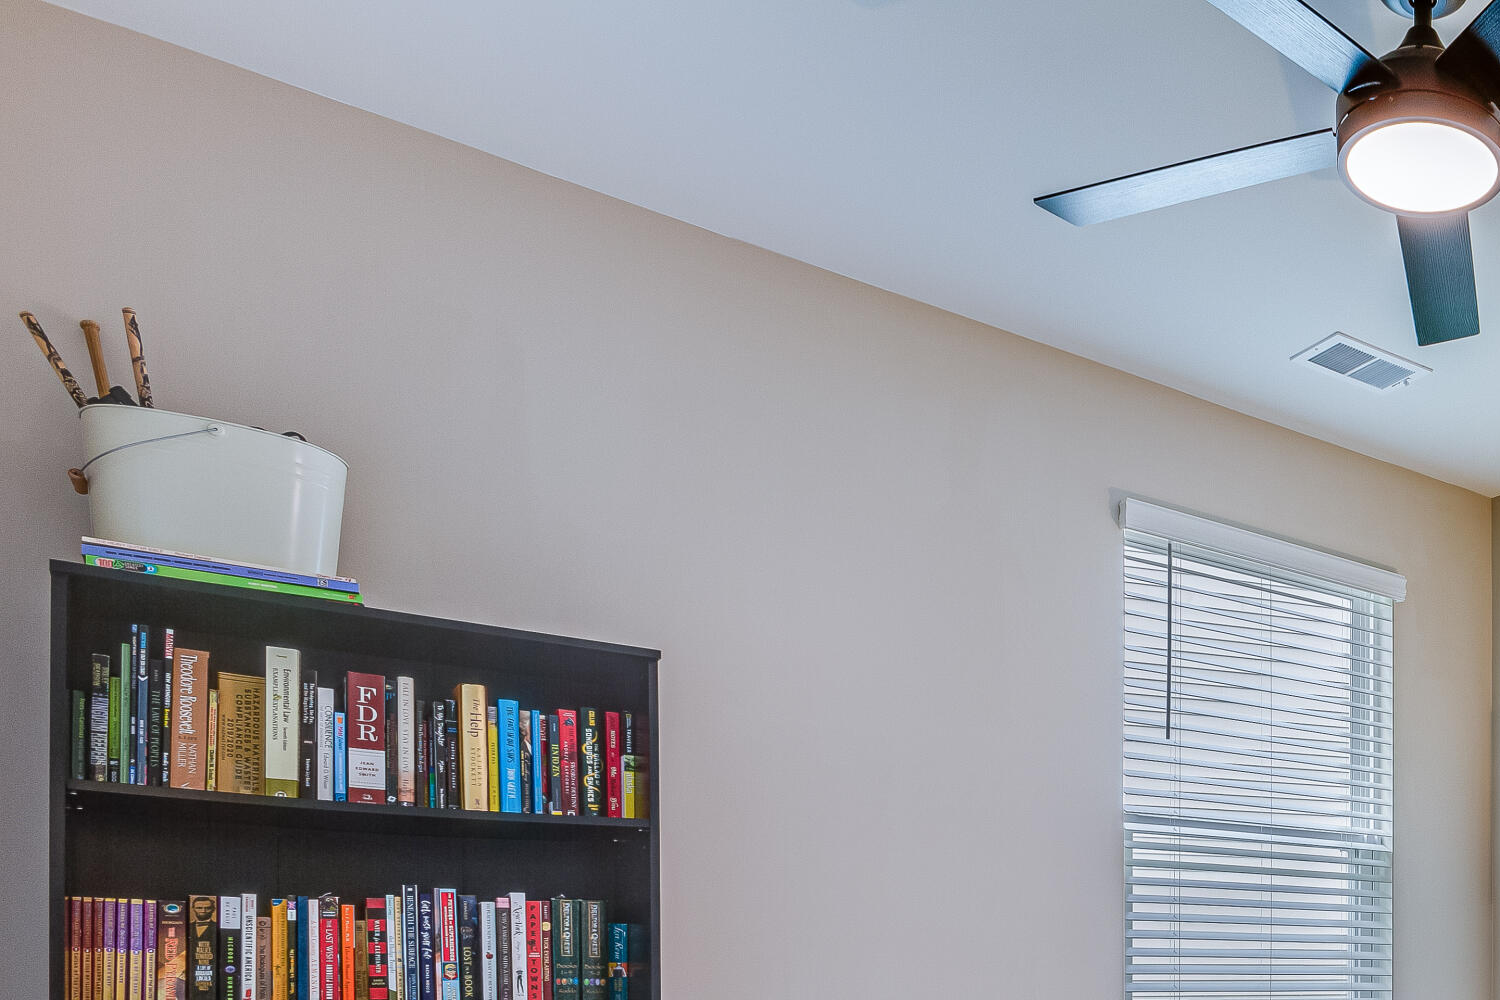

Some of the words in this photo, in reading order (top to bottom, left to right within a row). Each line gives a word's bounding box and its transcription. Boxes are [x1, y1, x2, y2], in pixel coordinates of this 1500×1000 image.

[180, 656, 198, 694] Theodore
[282, 670, 292, 710] Environmental
[150, 708, 160, 724] LAW
[178, 696, 196, 734] Roosevelt
[244, 690, 252, 744] SUBSTANCES
[252, 688, 260, 740] HAZARDOUS
[282, 712, 290, 724] Law
[356, 686, 378, 742] FDR
[472, 700, 480, 712] The
[506, 706, 514, 716] THE
[150, 726, 160, 736] OF
[234, 694, 242, 750] COMPLIANCE
[436, 722, 444, 746] Daughter
[468, 712, 482, 738] Help
[226, 718, 234, 758] 2019/2020
[552, 744, 560, 756] TEN
[150, 738, 160, 768] PEOPLES
[178, 742, 186, 768] MILLER
[188, 744, 196, 774] NATHAN
[234, 754, 242, 780] GUIDE
[242, 758, 252, 792] WASTES
[506, 768, 516, 782] JOHN
[407, 896, 416, 925] BENEATH
[245, 916, 253, 955] UNSCIENTIFIC
[408, 927, 416, 938] THE
[562, 932, 571, 954] QUEST
[591, 934, 600, 955] QUEST
[166, 938, 178, 960] RED
[408, 941, 417, 969] SURFACE
[464, 947, 472, 966] LOST
[464, 975, 473, 997] BOOK
